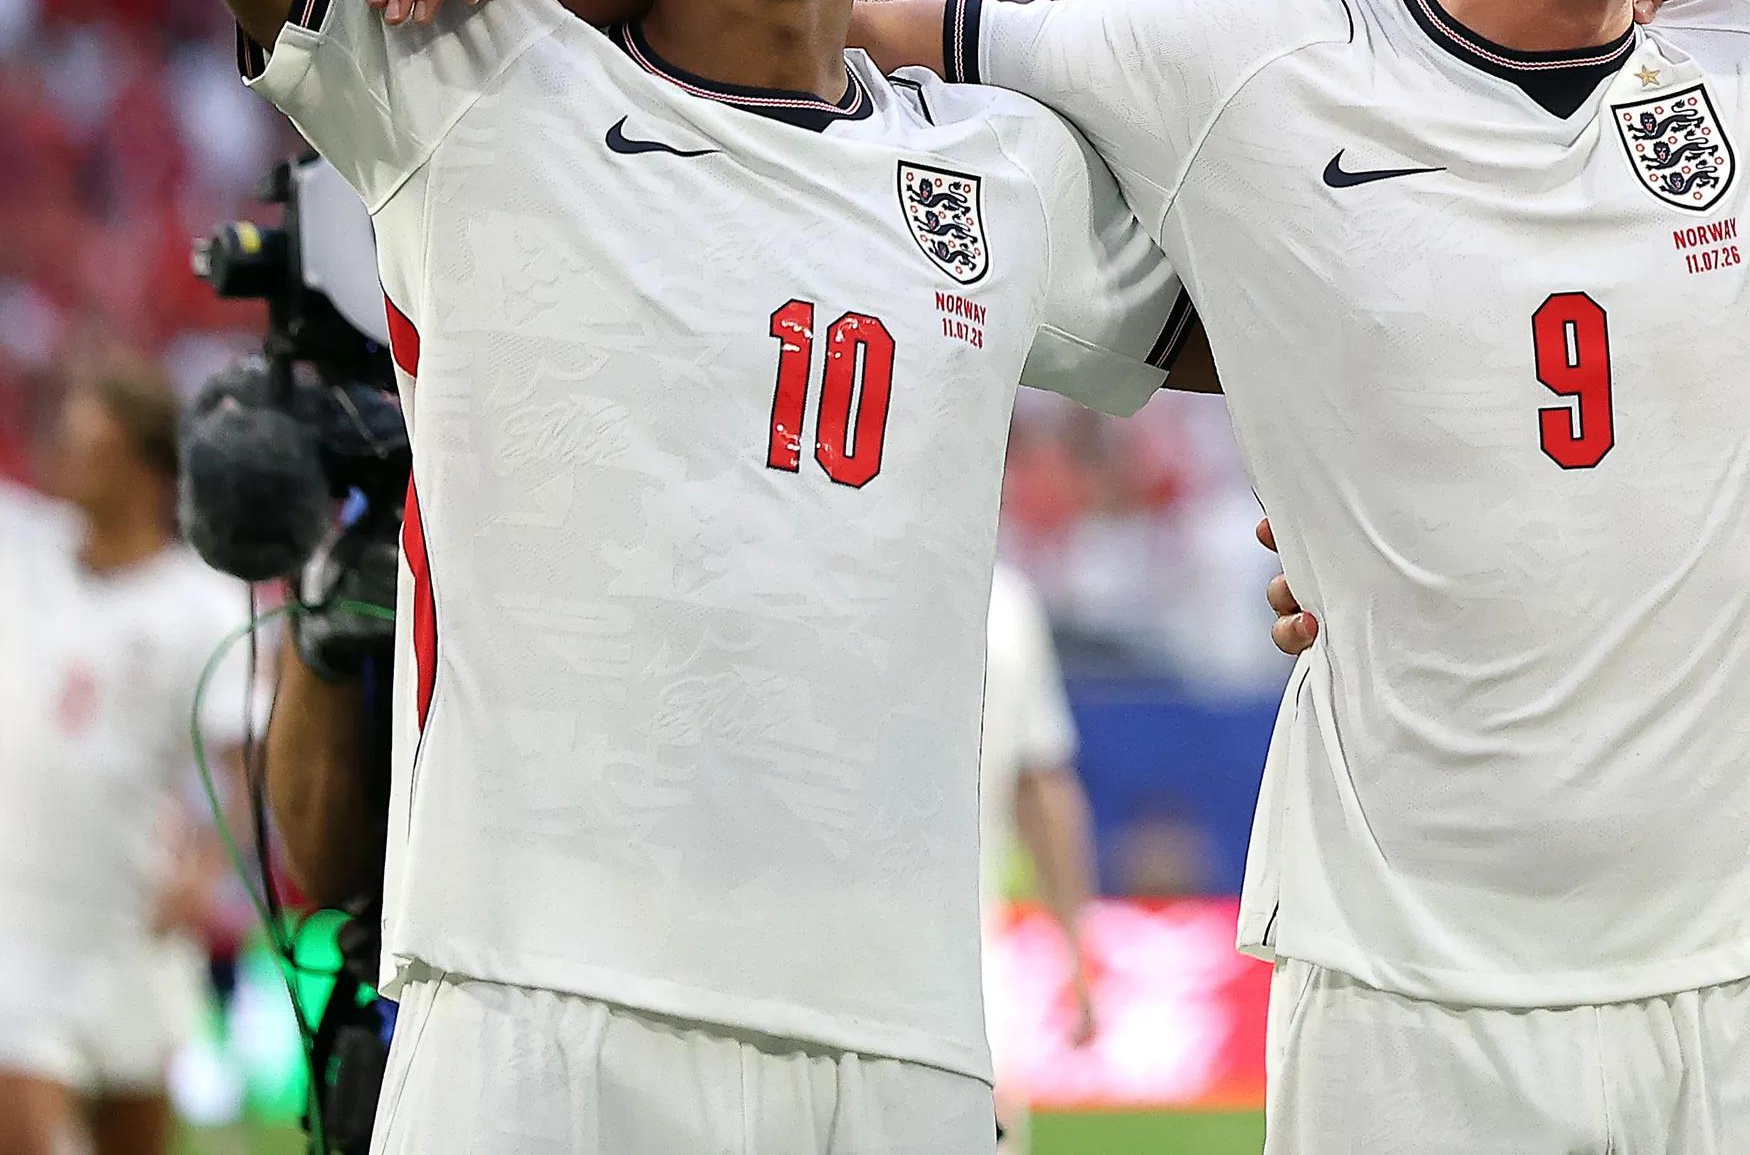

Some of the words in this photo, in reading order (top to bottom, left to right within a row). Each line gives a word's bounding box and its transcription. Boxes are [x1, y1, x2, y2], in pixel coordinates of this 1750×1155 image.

[1673, 217, 1737, 250] NORWAY
[1686, 245, 1741, 274] 11.07.26
[935, 291, 987, 326] NORWAY
[942, 317, 983, 349] 11.07.26
[766, 298, 896, 490] 10
[1531, 291, 1615, 469] 9
